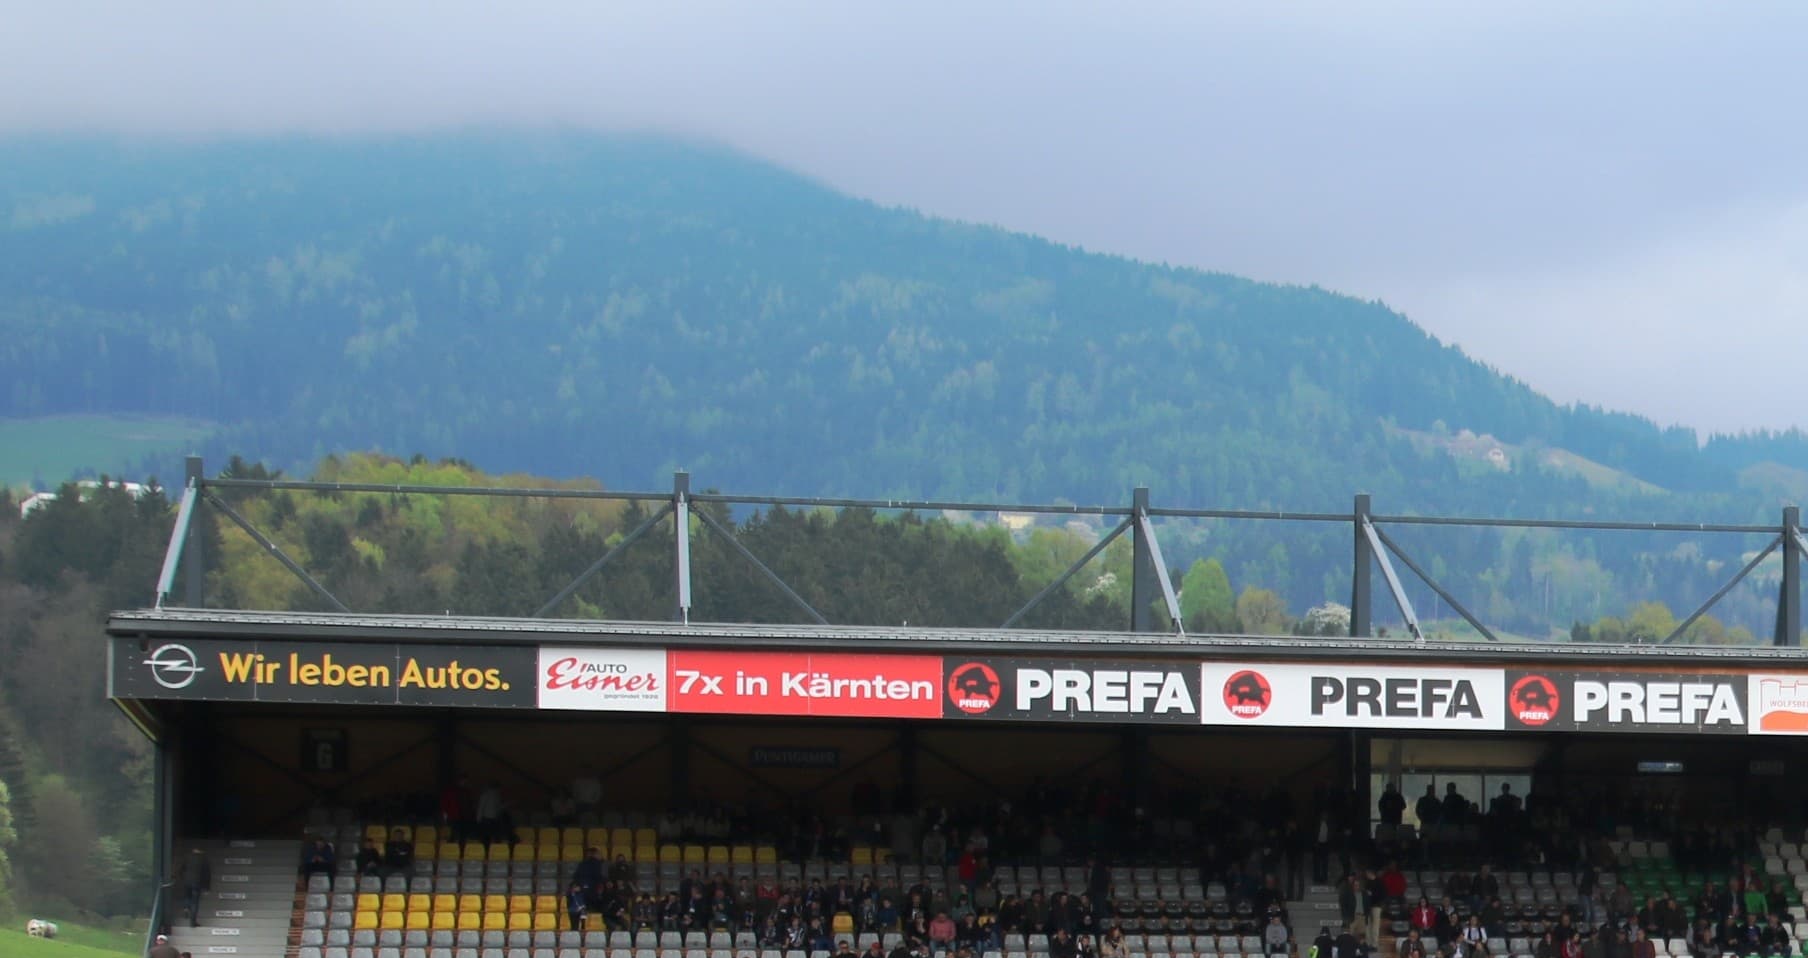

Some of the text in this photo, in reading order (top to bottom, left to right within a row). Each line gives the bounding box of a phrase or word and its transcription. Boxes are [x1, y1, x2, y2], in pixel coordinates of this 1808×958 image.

[219, 653, 510, 691] Wir leben Autos.
[545, 657, 659, 692] Eisner
[586, 664, 628, 674] AUTO
[675, 669, 934, 701] 7x in Kärnten
[959, 700, 990, 709] PREFA
[1015, 667, 1196, 715] PREFA
[1310, 677, 1484, 721] PREFA
[1573, 681, 1744, 726] PREFA
[1232, 706, 1262, 715] PREFA
[1519, 712, 1549, 721] PREFA
